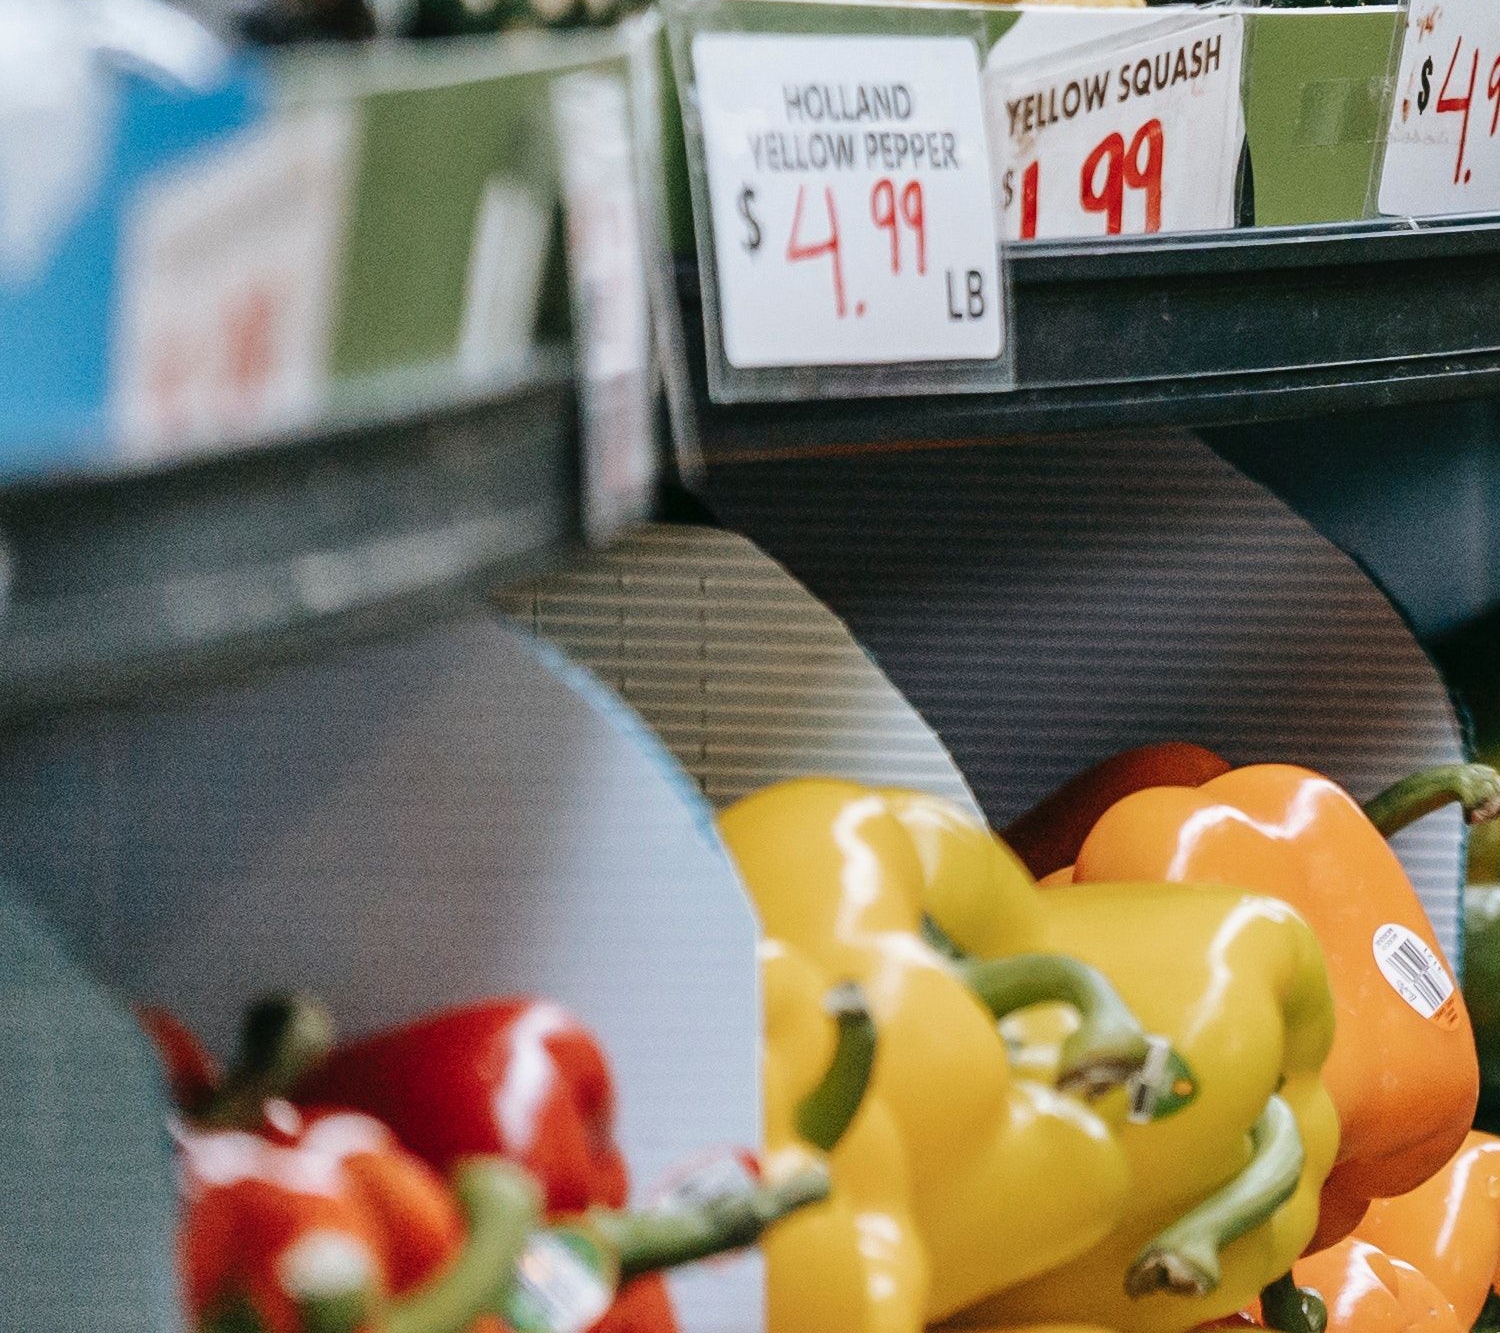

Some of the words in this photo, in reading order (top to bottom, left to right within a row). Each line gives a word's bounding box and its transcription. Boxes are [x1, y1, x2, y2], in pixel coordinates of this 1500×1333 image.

[783, 84, 911, 122] HOLLAND
[1005, 70, 1110, 136] YELLOW
[1117, 34, 1222, 103] SQUASH
[749, 131, 855, 171] YELLOW
[864, 131, 959, 171] PEPPER
[945, 269, 985, 323] LB
